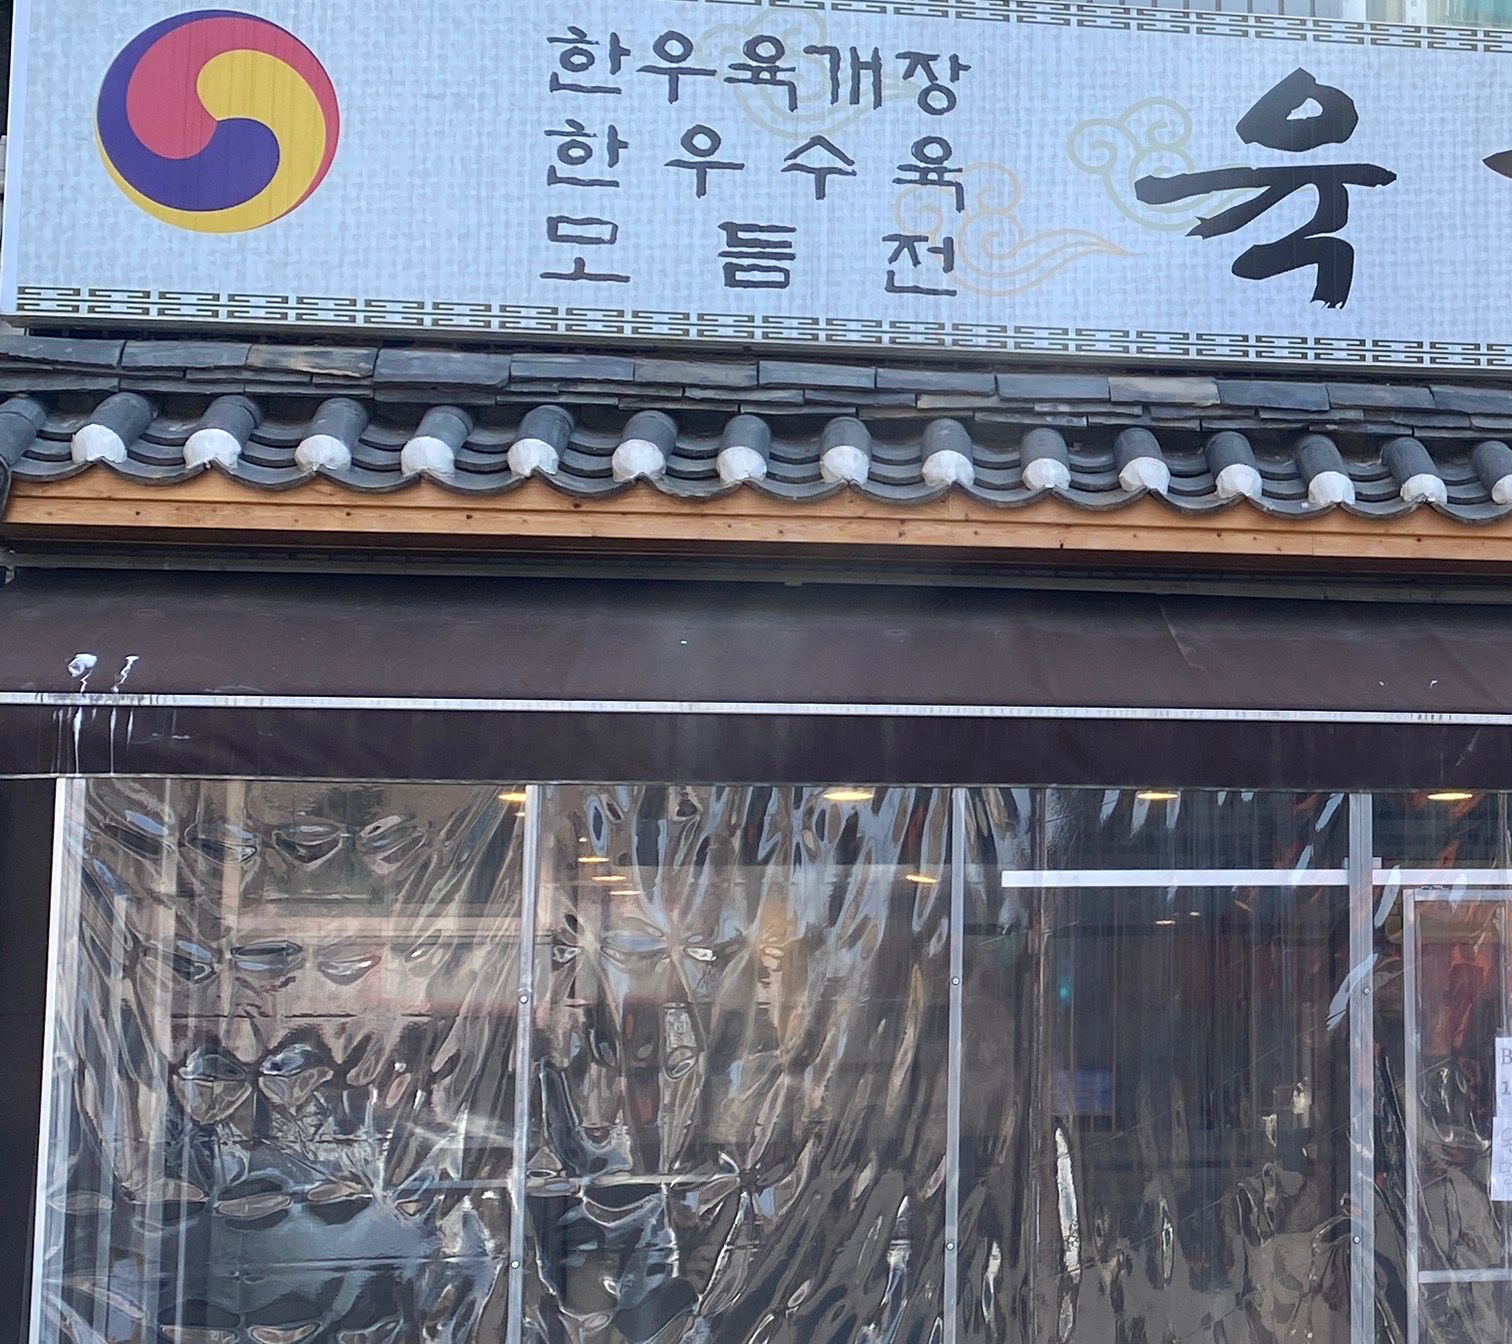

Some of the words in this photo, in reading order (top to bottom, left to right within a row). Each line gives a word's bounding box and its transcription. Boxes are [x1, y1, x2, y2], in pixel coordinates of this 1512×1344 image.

[546, 26, 972, 115] 한우육개장
[544, 118, 965, 213] 한우수육
[539, 215, 958, 296] 모듬전
